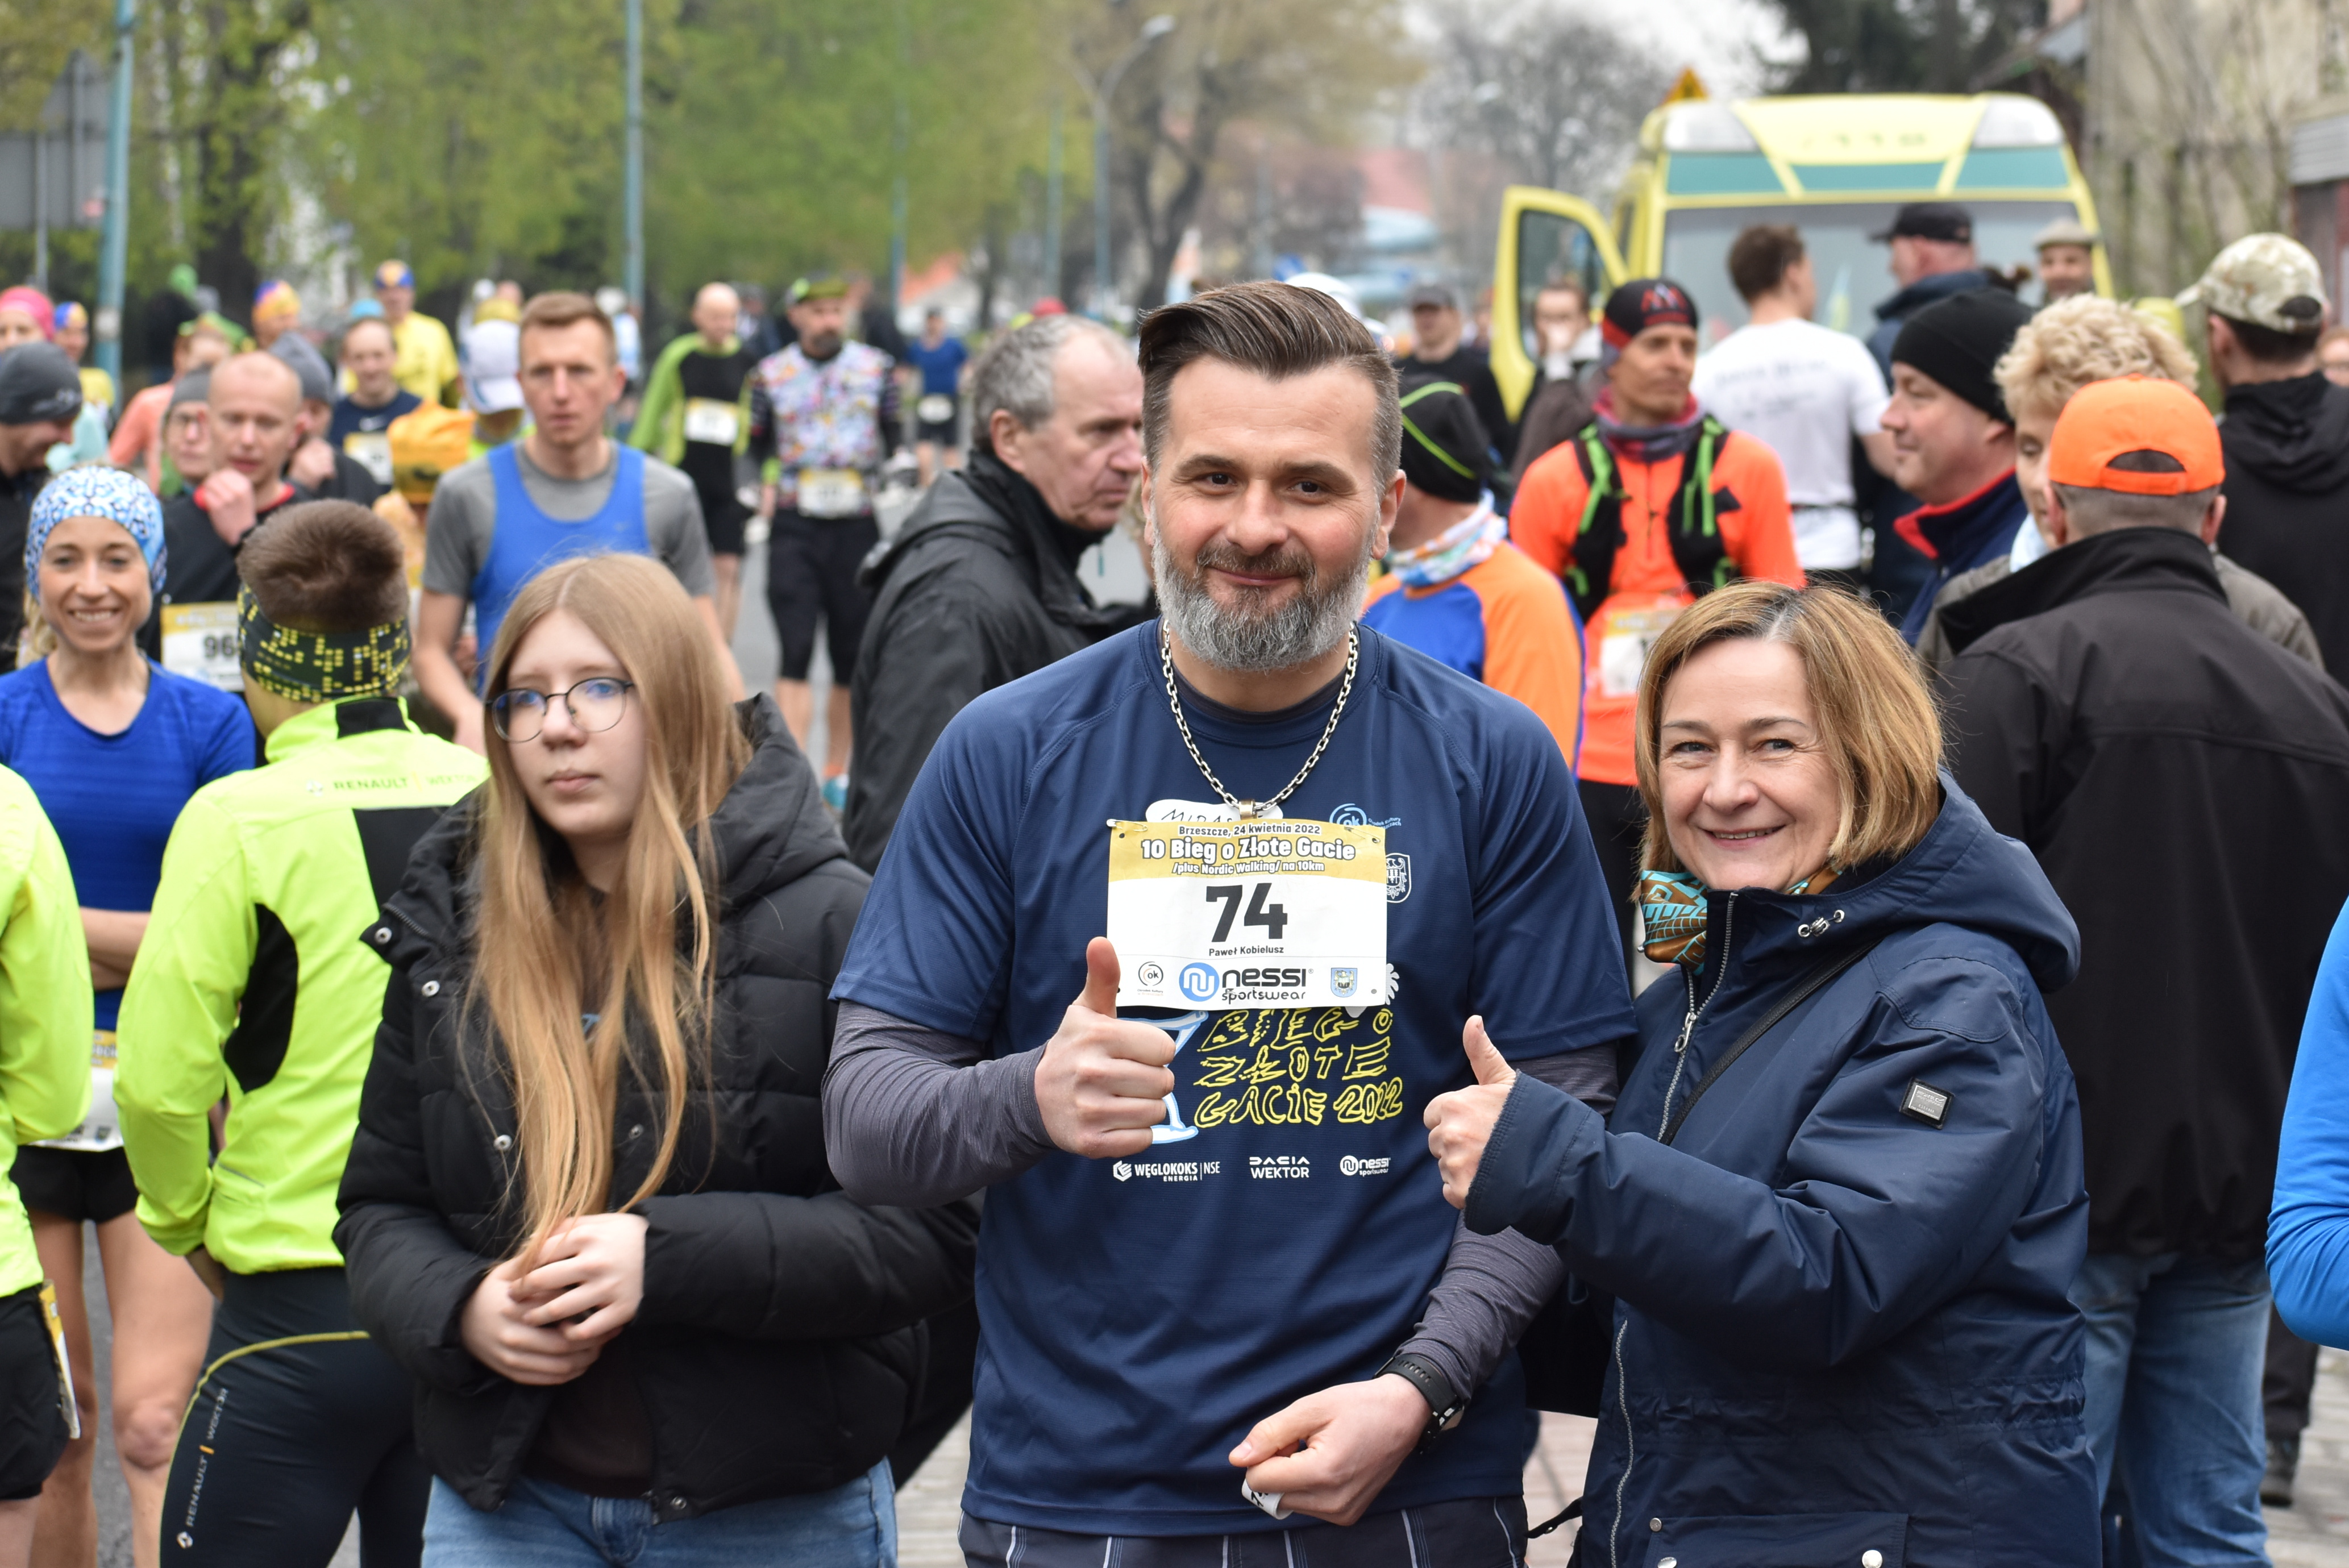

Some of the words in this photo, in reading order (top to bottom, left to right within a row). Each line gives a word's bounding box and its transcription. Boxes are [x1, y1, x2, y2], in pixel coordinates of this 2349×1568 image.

[334, 778, 408, 789] RENAULT
[1179, 826, 1232, 837] Brzeszcze,
[1234, 825, 1246, 835] 24
[1249, 822, 1291, 834] kwietnia
[1294, 825, 1321, 834] 2022
[1141, 839, 1166, 859] 10
[1170, 836, 1217, 865] Bieg
[1221, 843, 1235, 860] o
[1237, 835, 1292, 860] Złote
[1296, 837, 1356, 862] Gacie
[1172, 862, 1199, 874] /plus
[1201, 862, 1234, 875] Nordic
[1236, 860, 1280, 874] Walking/
[1282, 862, 1296, 871] na
[1297, 860, 1325, 872] 10km
[1206, 883, 1287, 942] 74
[1209, 947, 1237, 956] Paweł
[1240, 946, 1284, 955] Kobielusz
[1147, 970, 1159, 979] ok
[1221, 988, 1306, 1005] sportswear
[1197, 1007, 1359, 1051] BIEG
[1193, 1036, 1391, 1087] ZŁOTE
[1333, 1076, 1403, 1124] 2022
[1249, 1156, 1310, 1165] DACIA
[1134, 1162, 1198, 1178] WĘGLOKOKS
[1204, 1161, 1220, 1174] NSE
[1250, 1167, 1309, 1179] WEKTOR
[1359, 1168, 1388, 1177] sportswear
[185, 1455, 208, 1527] RENAULT
